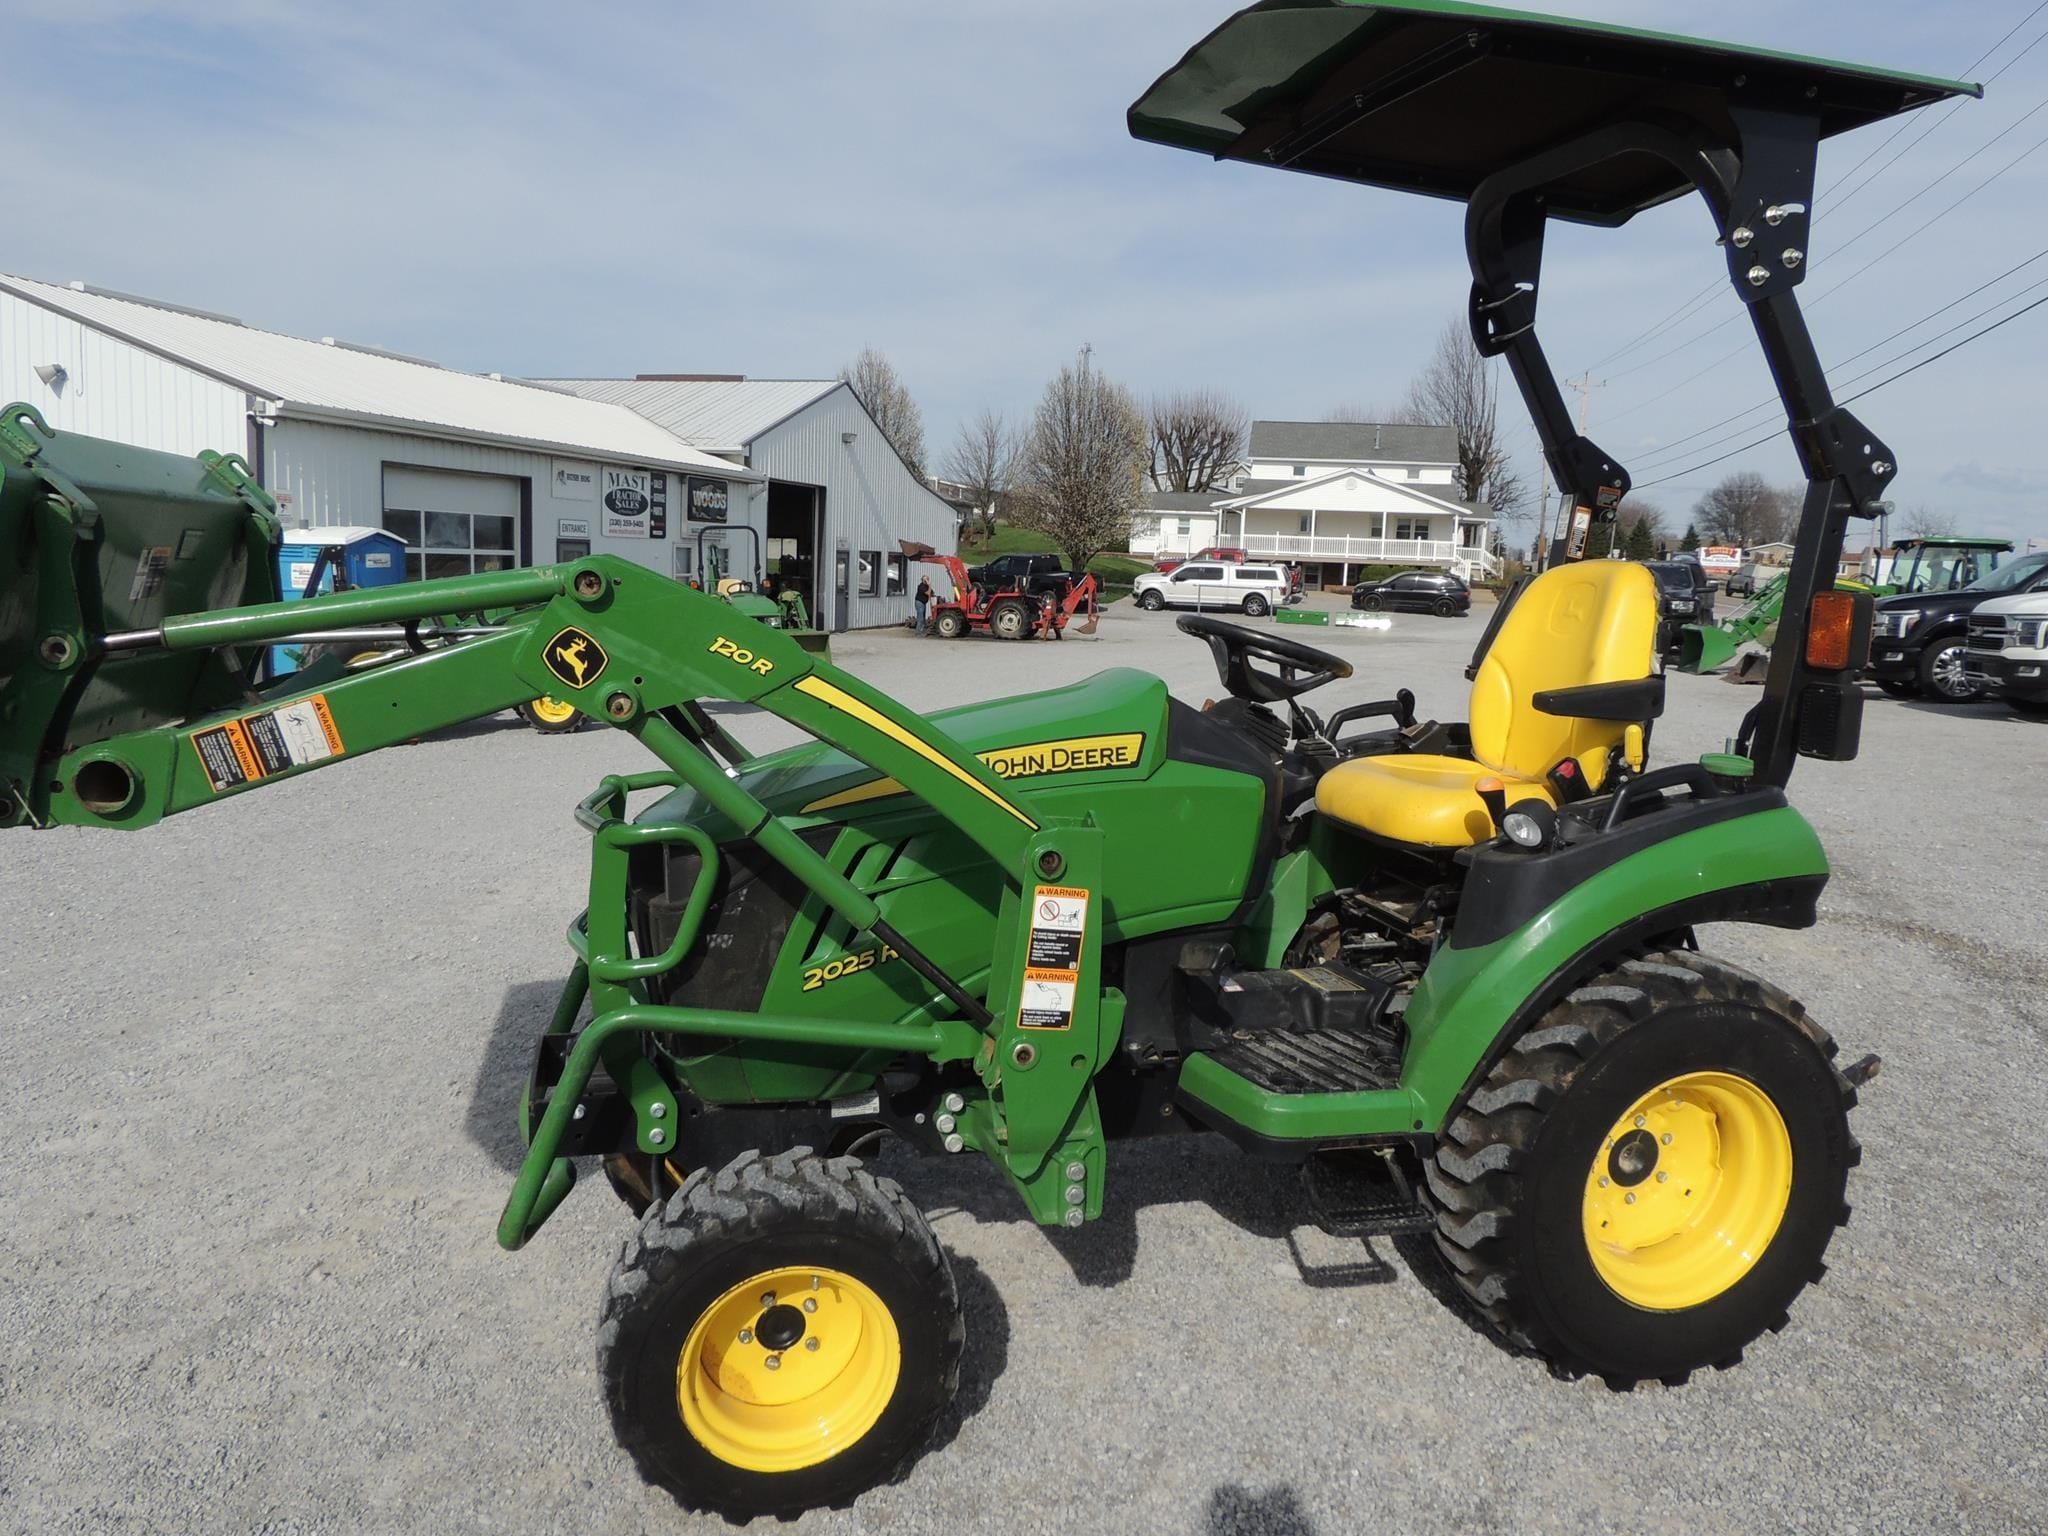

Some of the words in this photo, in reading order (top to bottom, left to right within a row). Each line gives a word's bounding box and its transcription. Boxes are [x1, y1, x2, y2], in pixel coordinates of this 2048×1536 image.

[608, 472, 648, 491] MAST
[611, 488, 642, 502] TRACTOR
[615, 499, 640, 510] SALES
[692, 490, 727, 509] WOODS
[561, 523, 587, 534] ENTRANCE
[319, 711, 339, 750] WARNING
[234, 738, 254, 777] WARNING
[1051, 746, 1129, 769] DEERE
[1046, 887, 1086, 898] WARNING
[802, 949, 876, 992] 2025
[1035, 972, 1075, 982] WARNING
